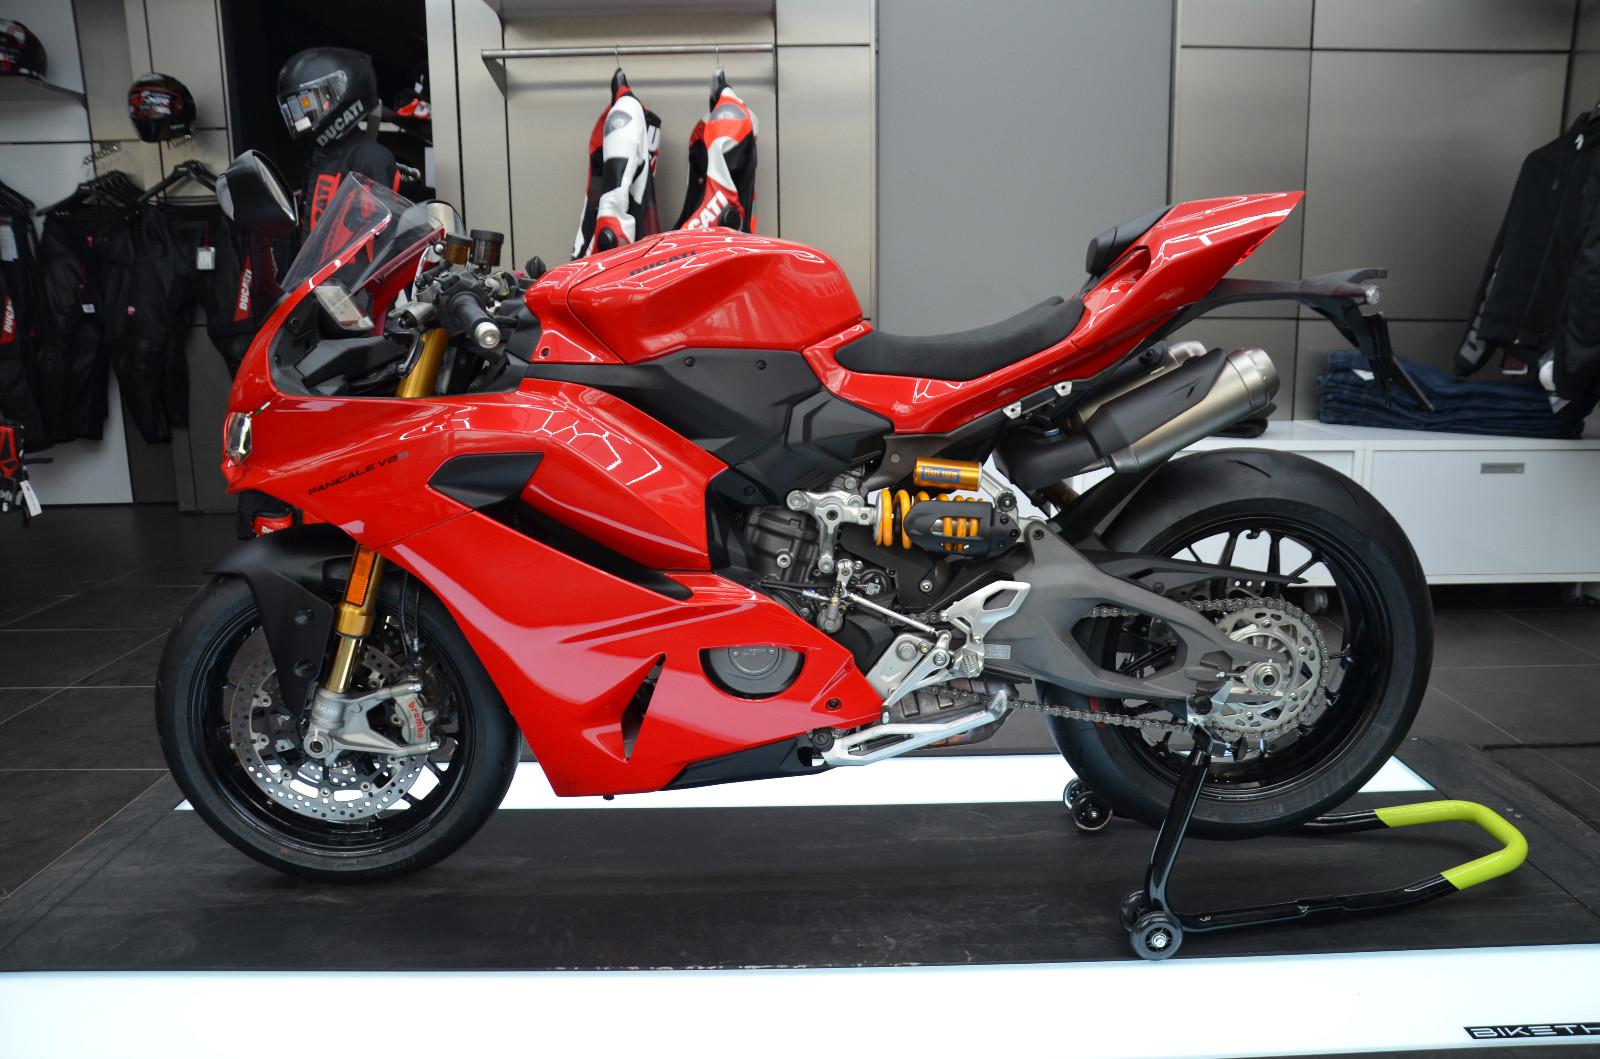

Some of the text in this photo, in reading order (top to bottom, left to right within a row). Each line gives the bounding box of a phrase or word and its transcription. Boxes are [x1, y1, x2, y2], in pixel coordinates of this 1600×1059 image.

[316, 99, 364, 147] DUCATI
[629, 250, 697, 277] DUCATI
[239, 268, 253, 311] DUCATI
[408, 700, 424, 739] brembo
